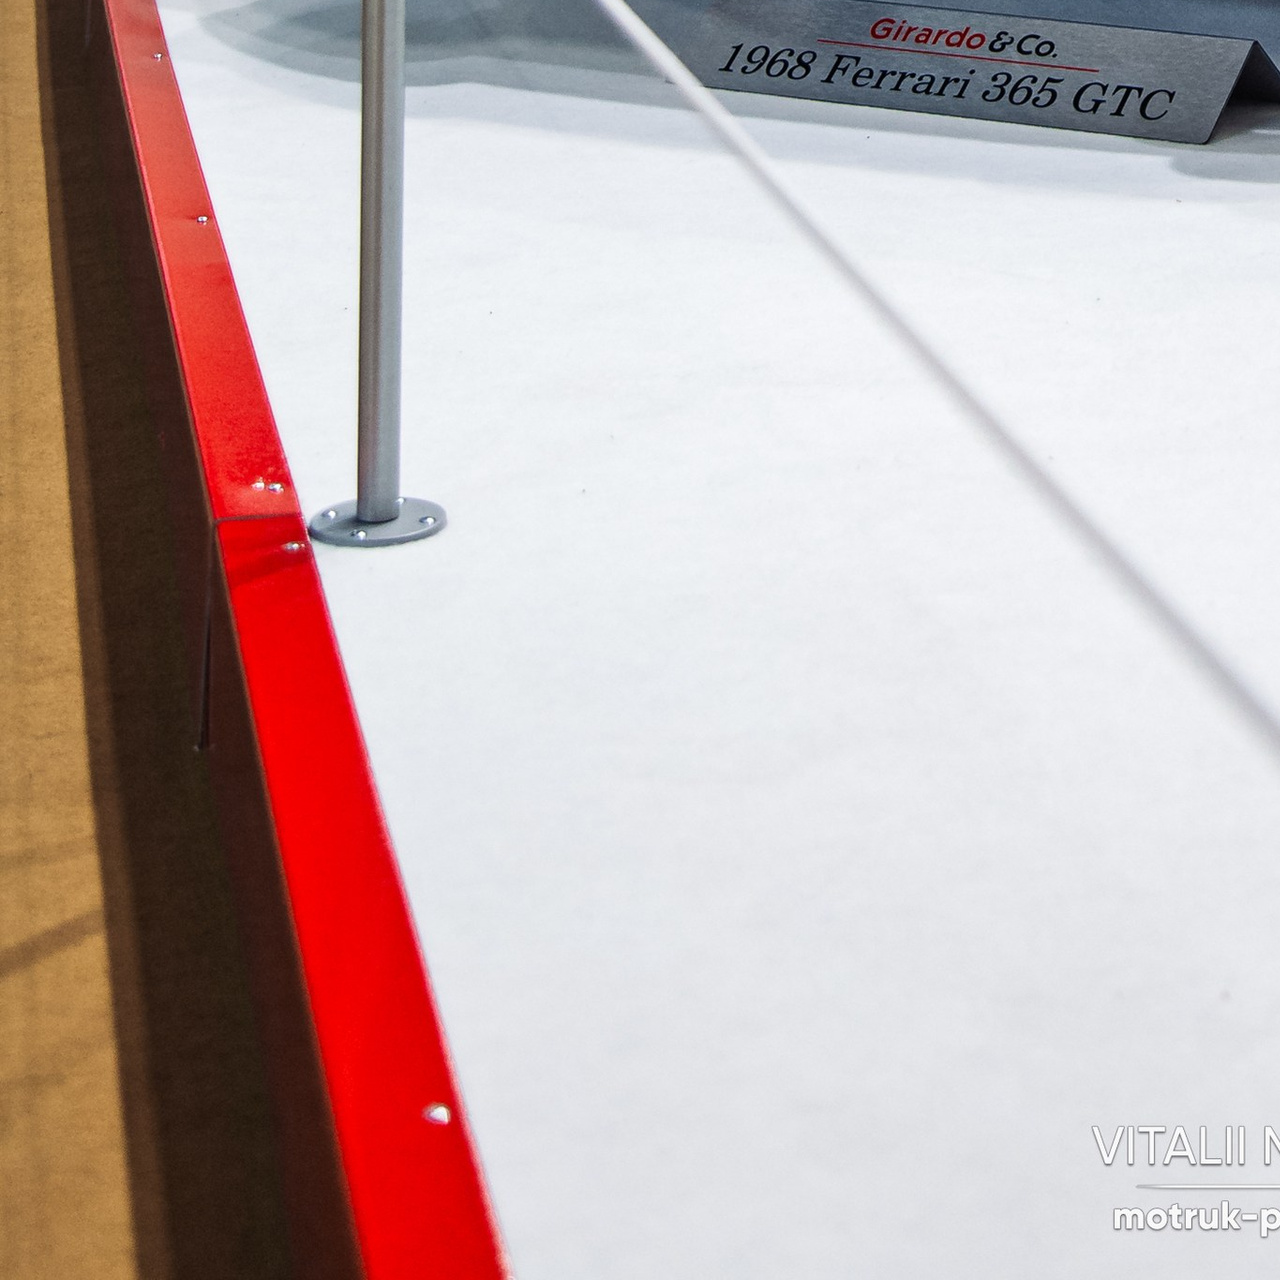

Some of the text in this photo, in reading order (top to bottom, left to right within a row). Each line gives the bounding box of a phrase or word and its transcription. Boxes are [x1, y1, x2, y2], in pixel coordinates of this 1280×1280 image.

[869, 17, 986, 50] Girardo
[717, 42, 1176, 121] 1968 Ferrari 365 GTC
